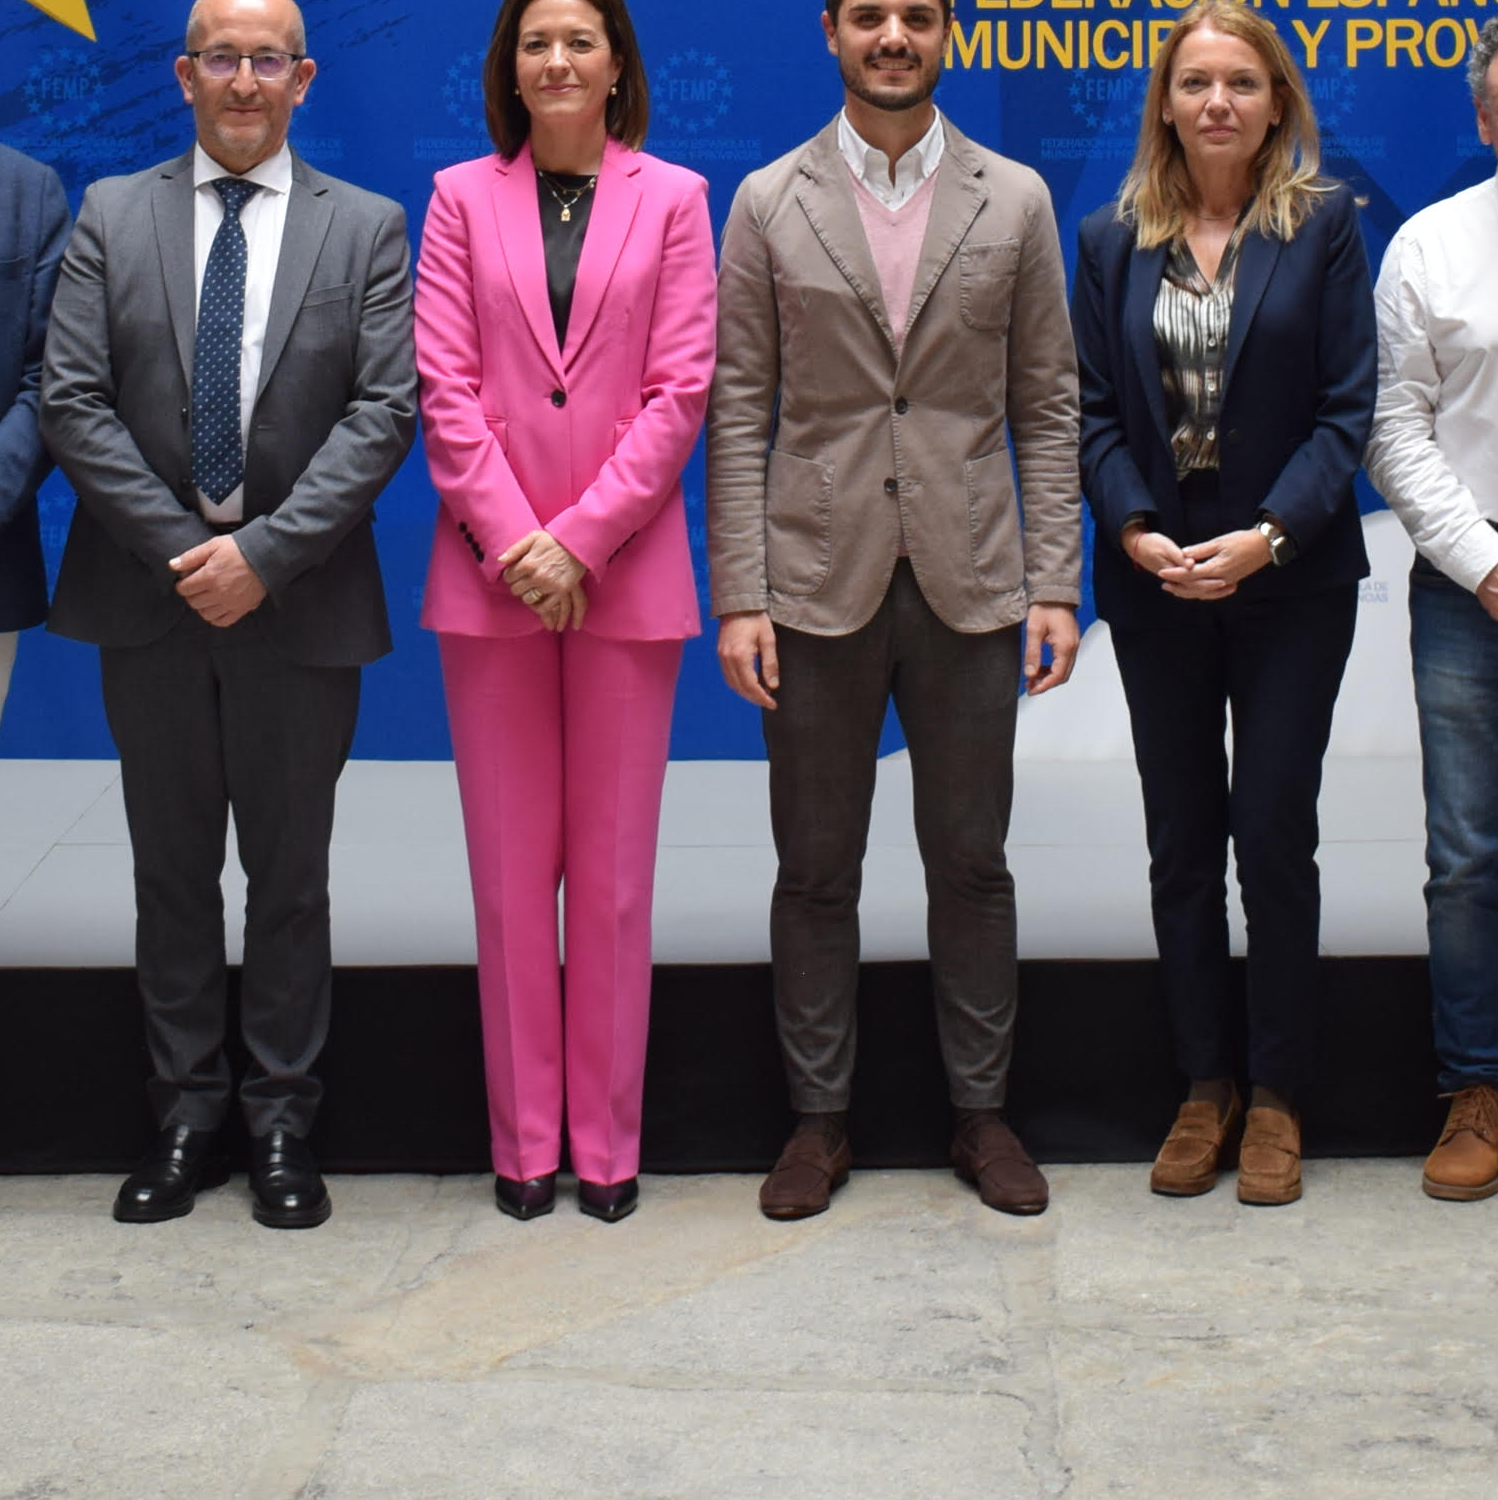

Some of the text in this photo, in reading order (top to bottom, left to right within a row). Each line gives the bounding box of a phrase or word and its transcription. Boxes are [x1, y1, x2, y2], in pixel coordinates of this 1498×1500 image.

[1292, 19, 1330, 68] Y
[41, 77, 89, 100] FEMP
[669, 79, 717, 102] FEMP
[1086, 79, 1134, 102] FEMP
